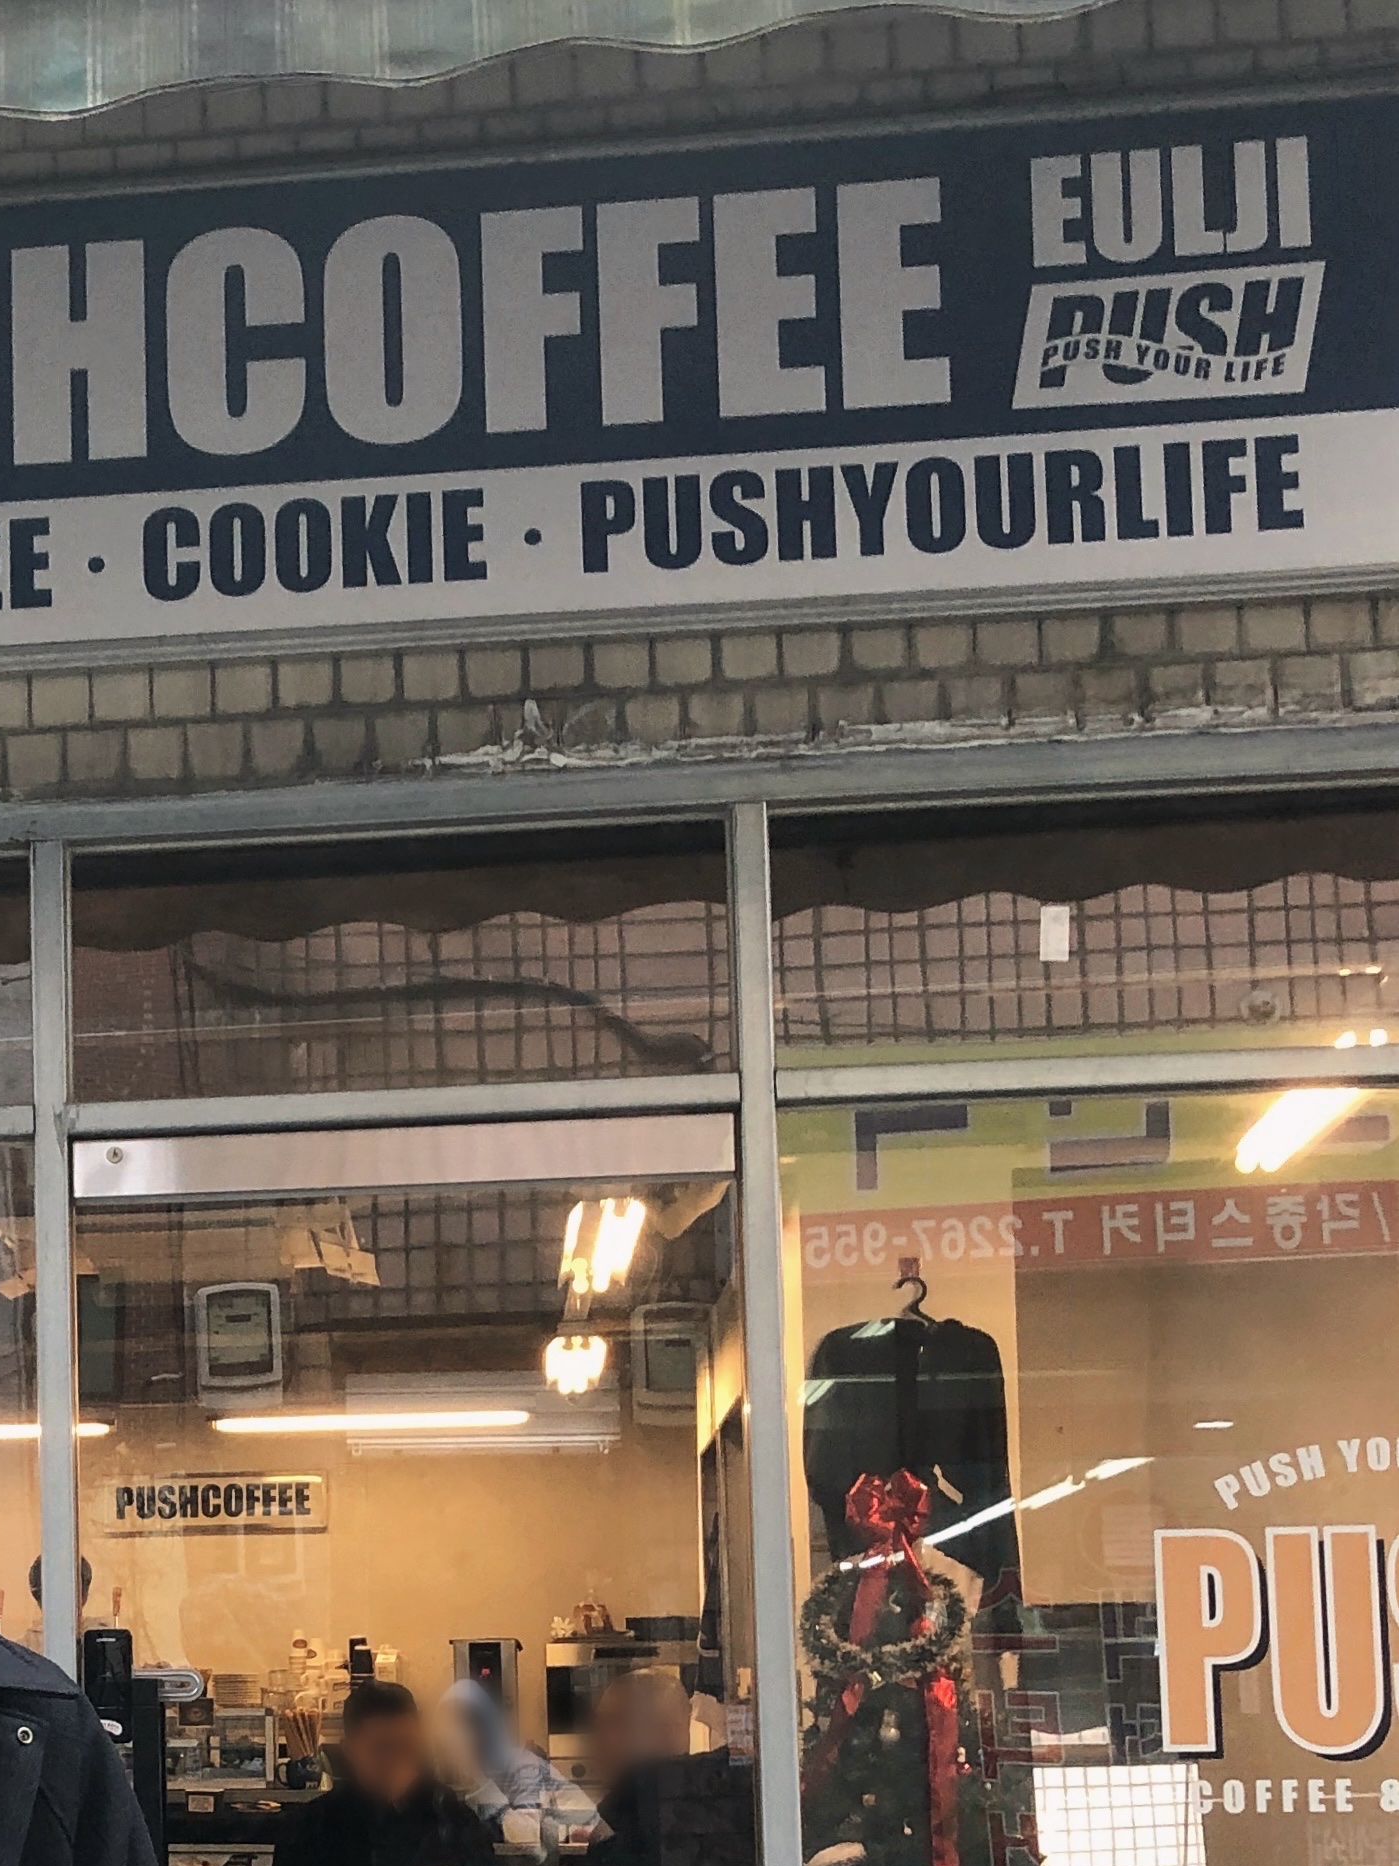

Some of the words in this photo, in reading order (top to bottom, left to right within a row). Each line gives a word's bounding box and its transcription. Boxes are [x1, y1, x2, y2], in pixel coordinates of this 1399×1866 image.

[1030, 135, 1312, 268] EULJI
[1038, 275, 1306, 389] PUSH
[1040, 338, 1123, 368] PUSH
[1135, 342, 1212, 381] YOUR
[1223, 353, 1287, 383] LIFE
[141, 488, 488, 602] COOKIE
[580, 433, 1306, 574] PUSHYOURLIFE
[115, 1482, 311, 1520] PUSHCOFFEE
[1213, 1445, 1326, 1511] PUSH
[1337, 1436, 1399, 1473] YO
[1154, 1524, 1399, 1760] PU
[1191, 1778, 1354, 1814] COFFEE
